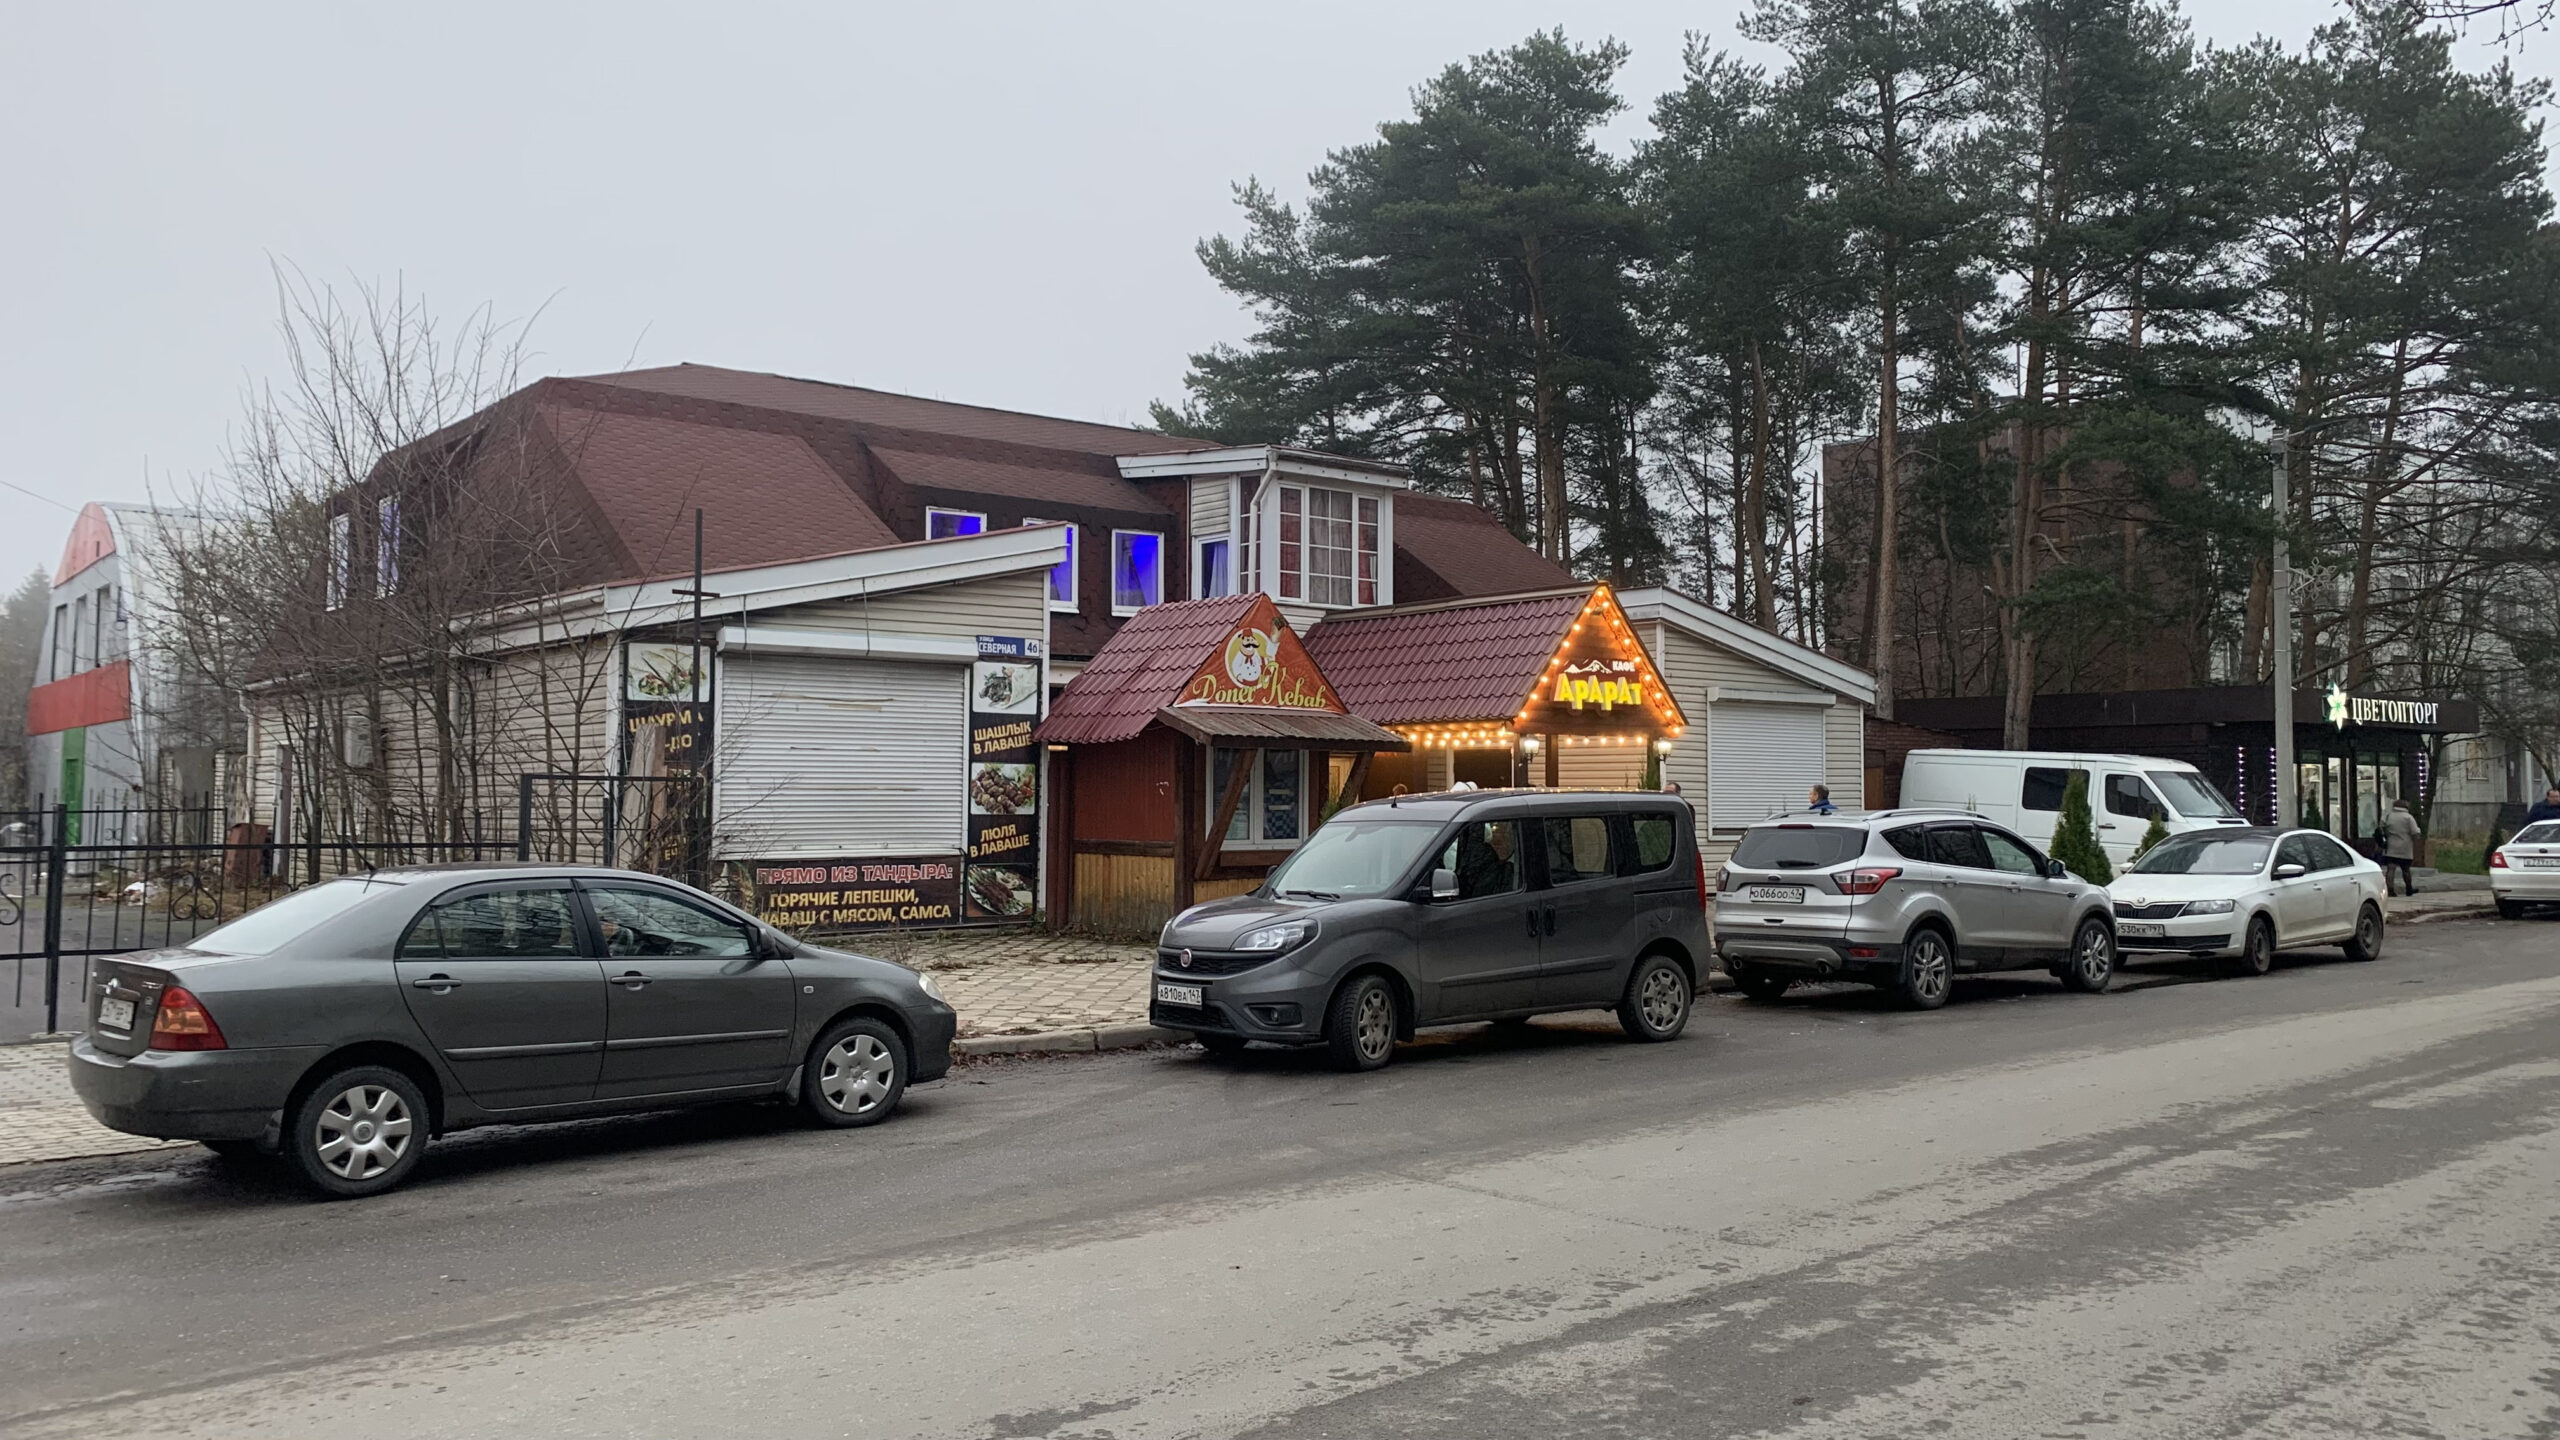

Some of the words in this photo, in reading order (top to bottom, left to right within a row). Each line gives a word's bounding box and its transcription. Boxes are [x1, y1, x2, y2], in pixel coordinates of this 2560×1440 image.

[978, 642, 1017, 655] СЕВЕРНАЯ
[1612, 661, 1635, 672] КАФЕ
[1192, 674, 1257, 703] Döner
[1260, 661, 1326, 708] Kebab
[2352, 697, 2438, 726] ЦВЕТОПТОРГ
[974, 720, 1032, 742] ШАШЛЫК
[973, 742, 982, 755] В
[983, 733, 1032, 753] ЛАВАШЕ
[980, 824, 1017, 842] ЛЮЛЯ
[969, 845, 979, 858] В
[980, 834, 1030, 856] ЛАВАШЕ
[756, 867, 827, 885] ПРЯМО
[831, 866, 858, 883] ИЗ
[862, 863, 953, 884] ТАНДЫРА:
[770, 891, 838, 908] ГОРЯЧИЕ
[841, 888, 919, 905] ЛЕПЕШКИ,
[820, 910, 830, 924] С
[833, 906, 897, 924] МЯСОМ,
[900, 904, 951, 920] САМСА
